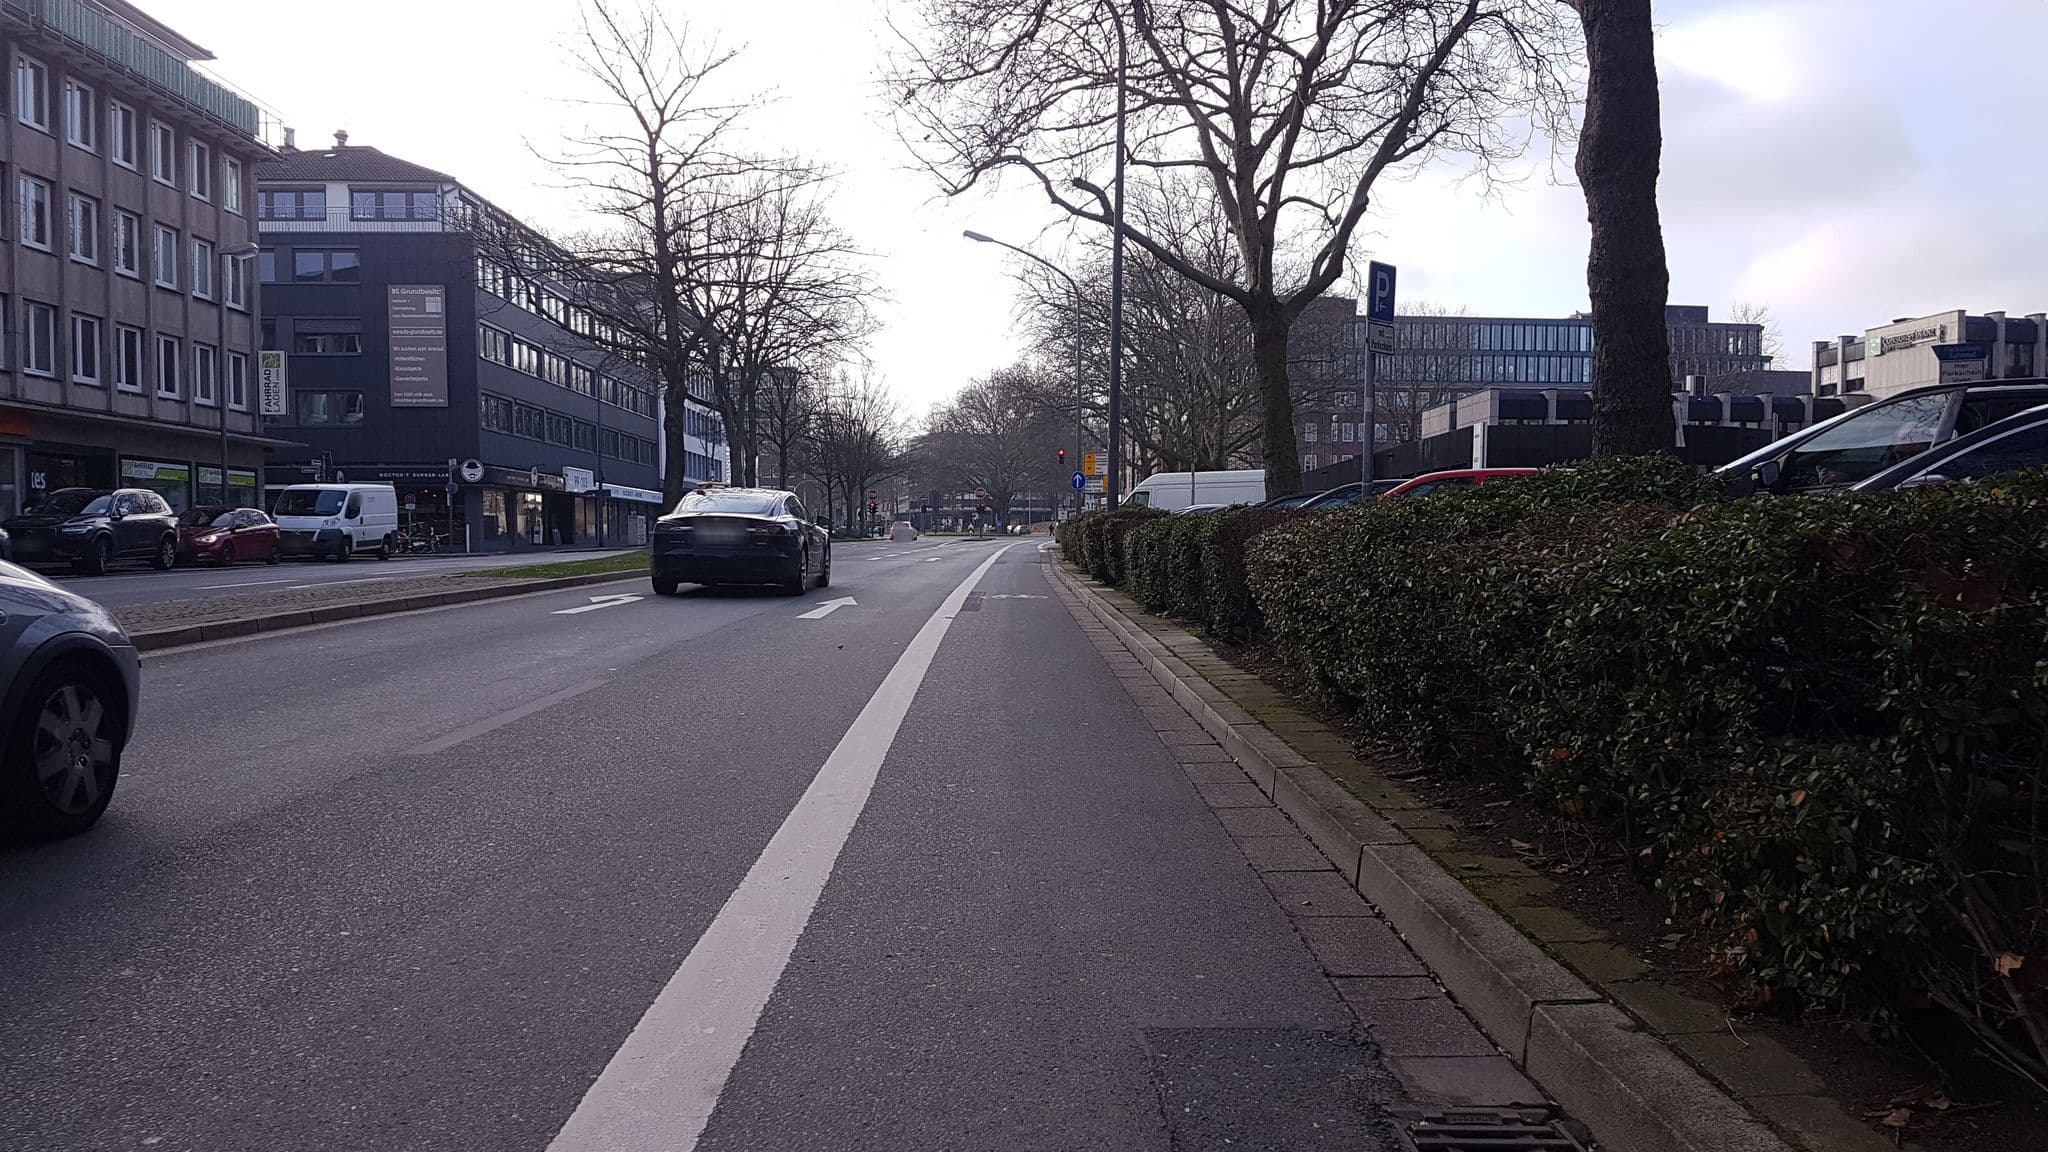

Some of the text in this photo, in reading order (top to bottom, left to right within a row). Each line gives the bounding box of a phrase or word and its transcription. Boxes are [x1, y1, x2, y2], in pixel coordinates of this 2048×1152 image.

[1375, 270, 1390, 312] P
[263, 368, 272, 413] FAHRRAD
[1942, 369, 1982, 377] Parkschein
[272, 381, 281, 413] LADEN
